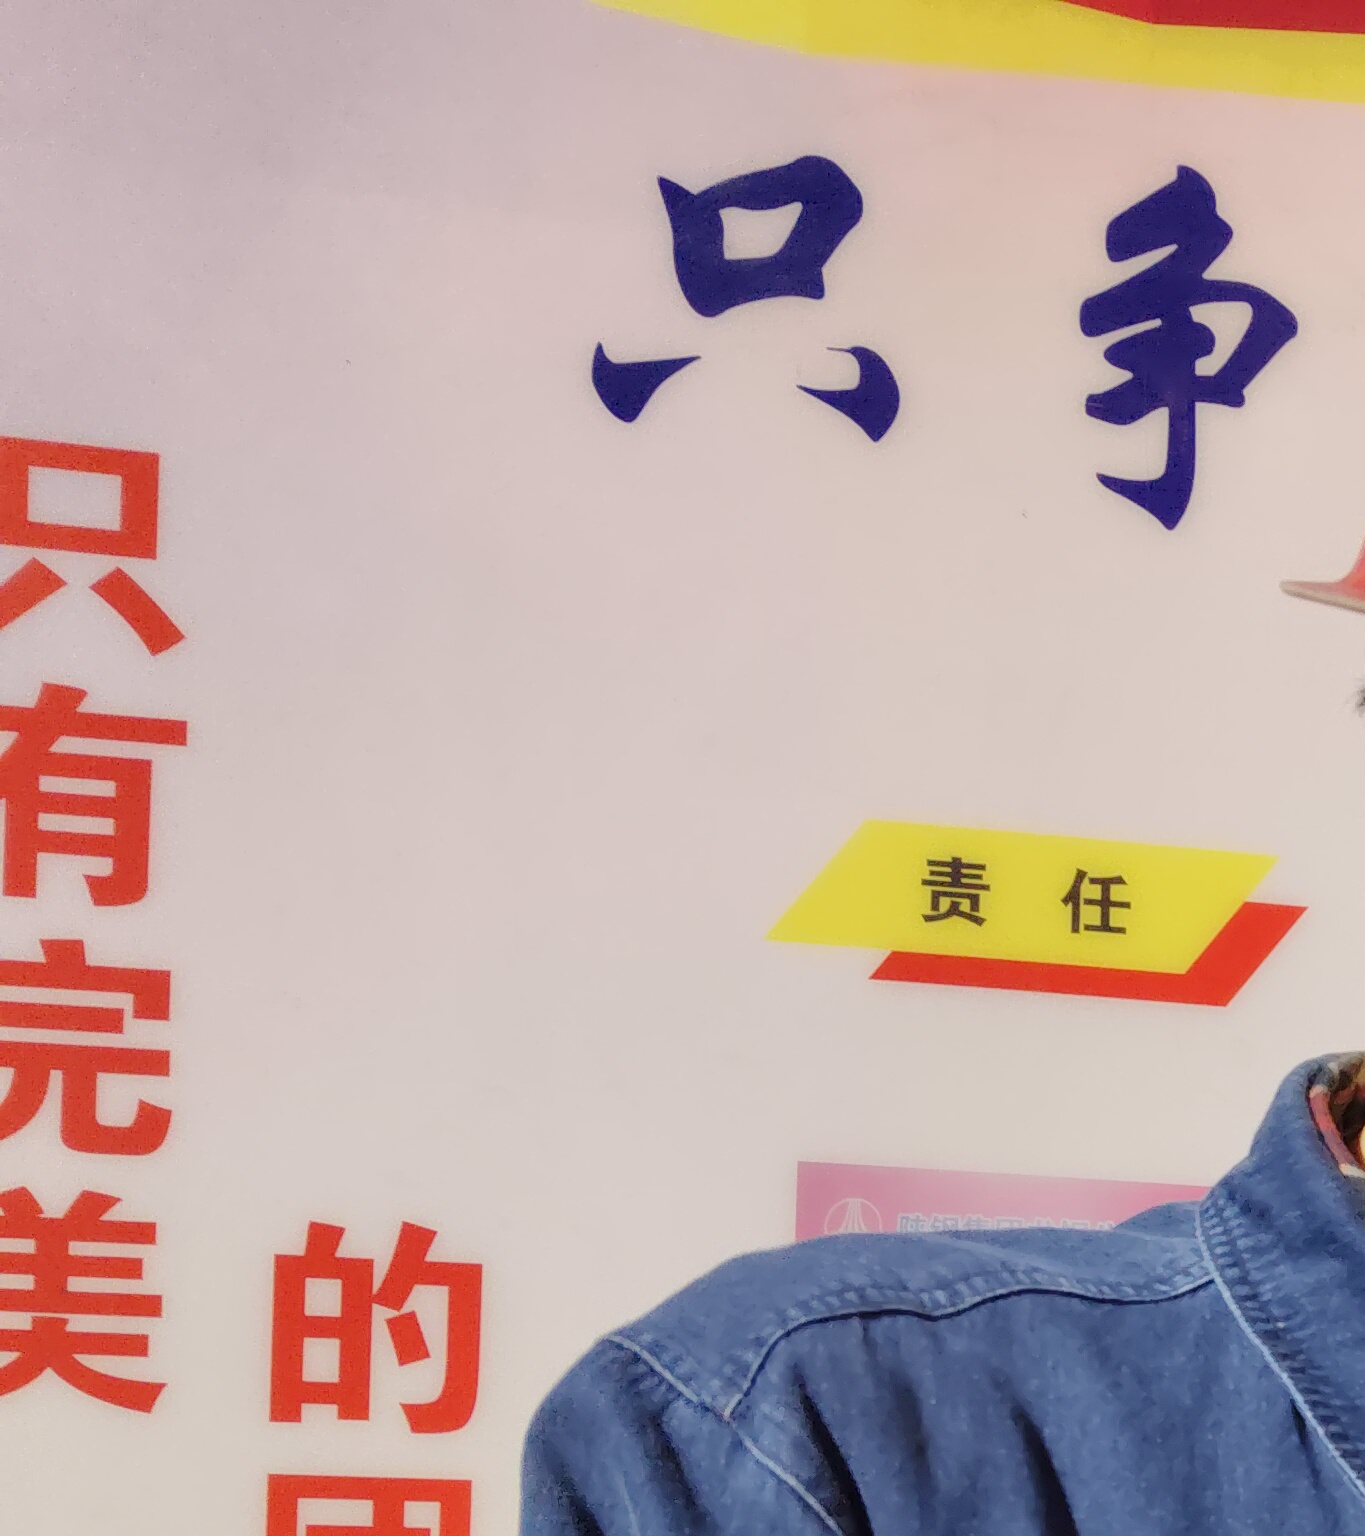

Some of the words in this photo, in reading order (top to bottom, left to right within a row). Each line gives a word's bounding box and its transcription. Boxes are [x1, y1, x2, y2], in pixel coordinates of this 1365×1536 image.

[0, 435, 188, 1414] 只有完美
[920, 855, 1133, 936] 责任
